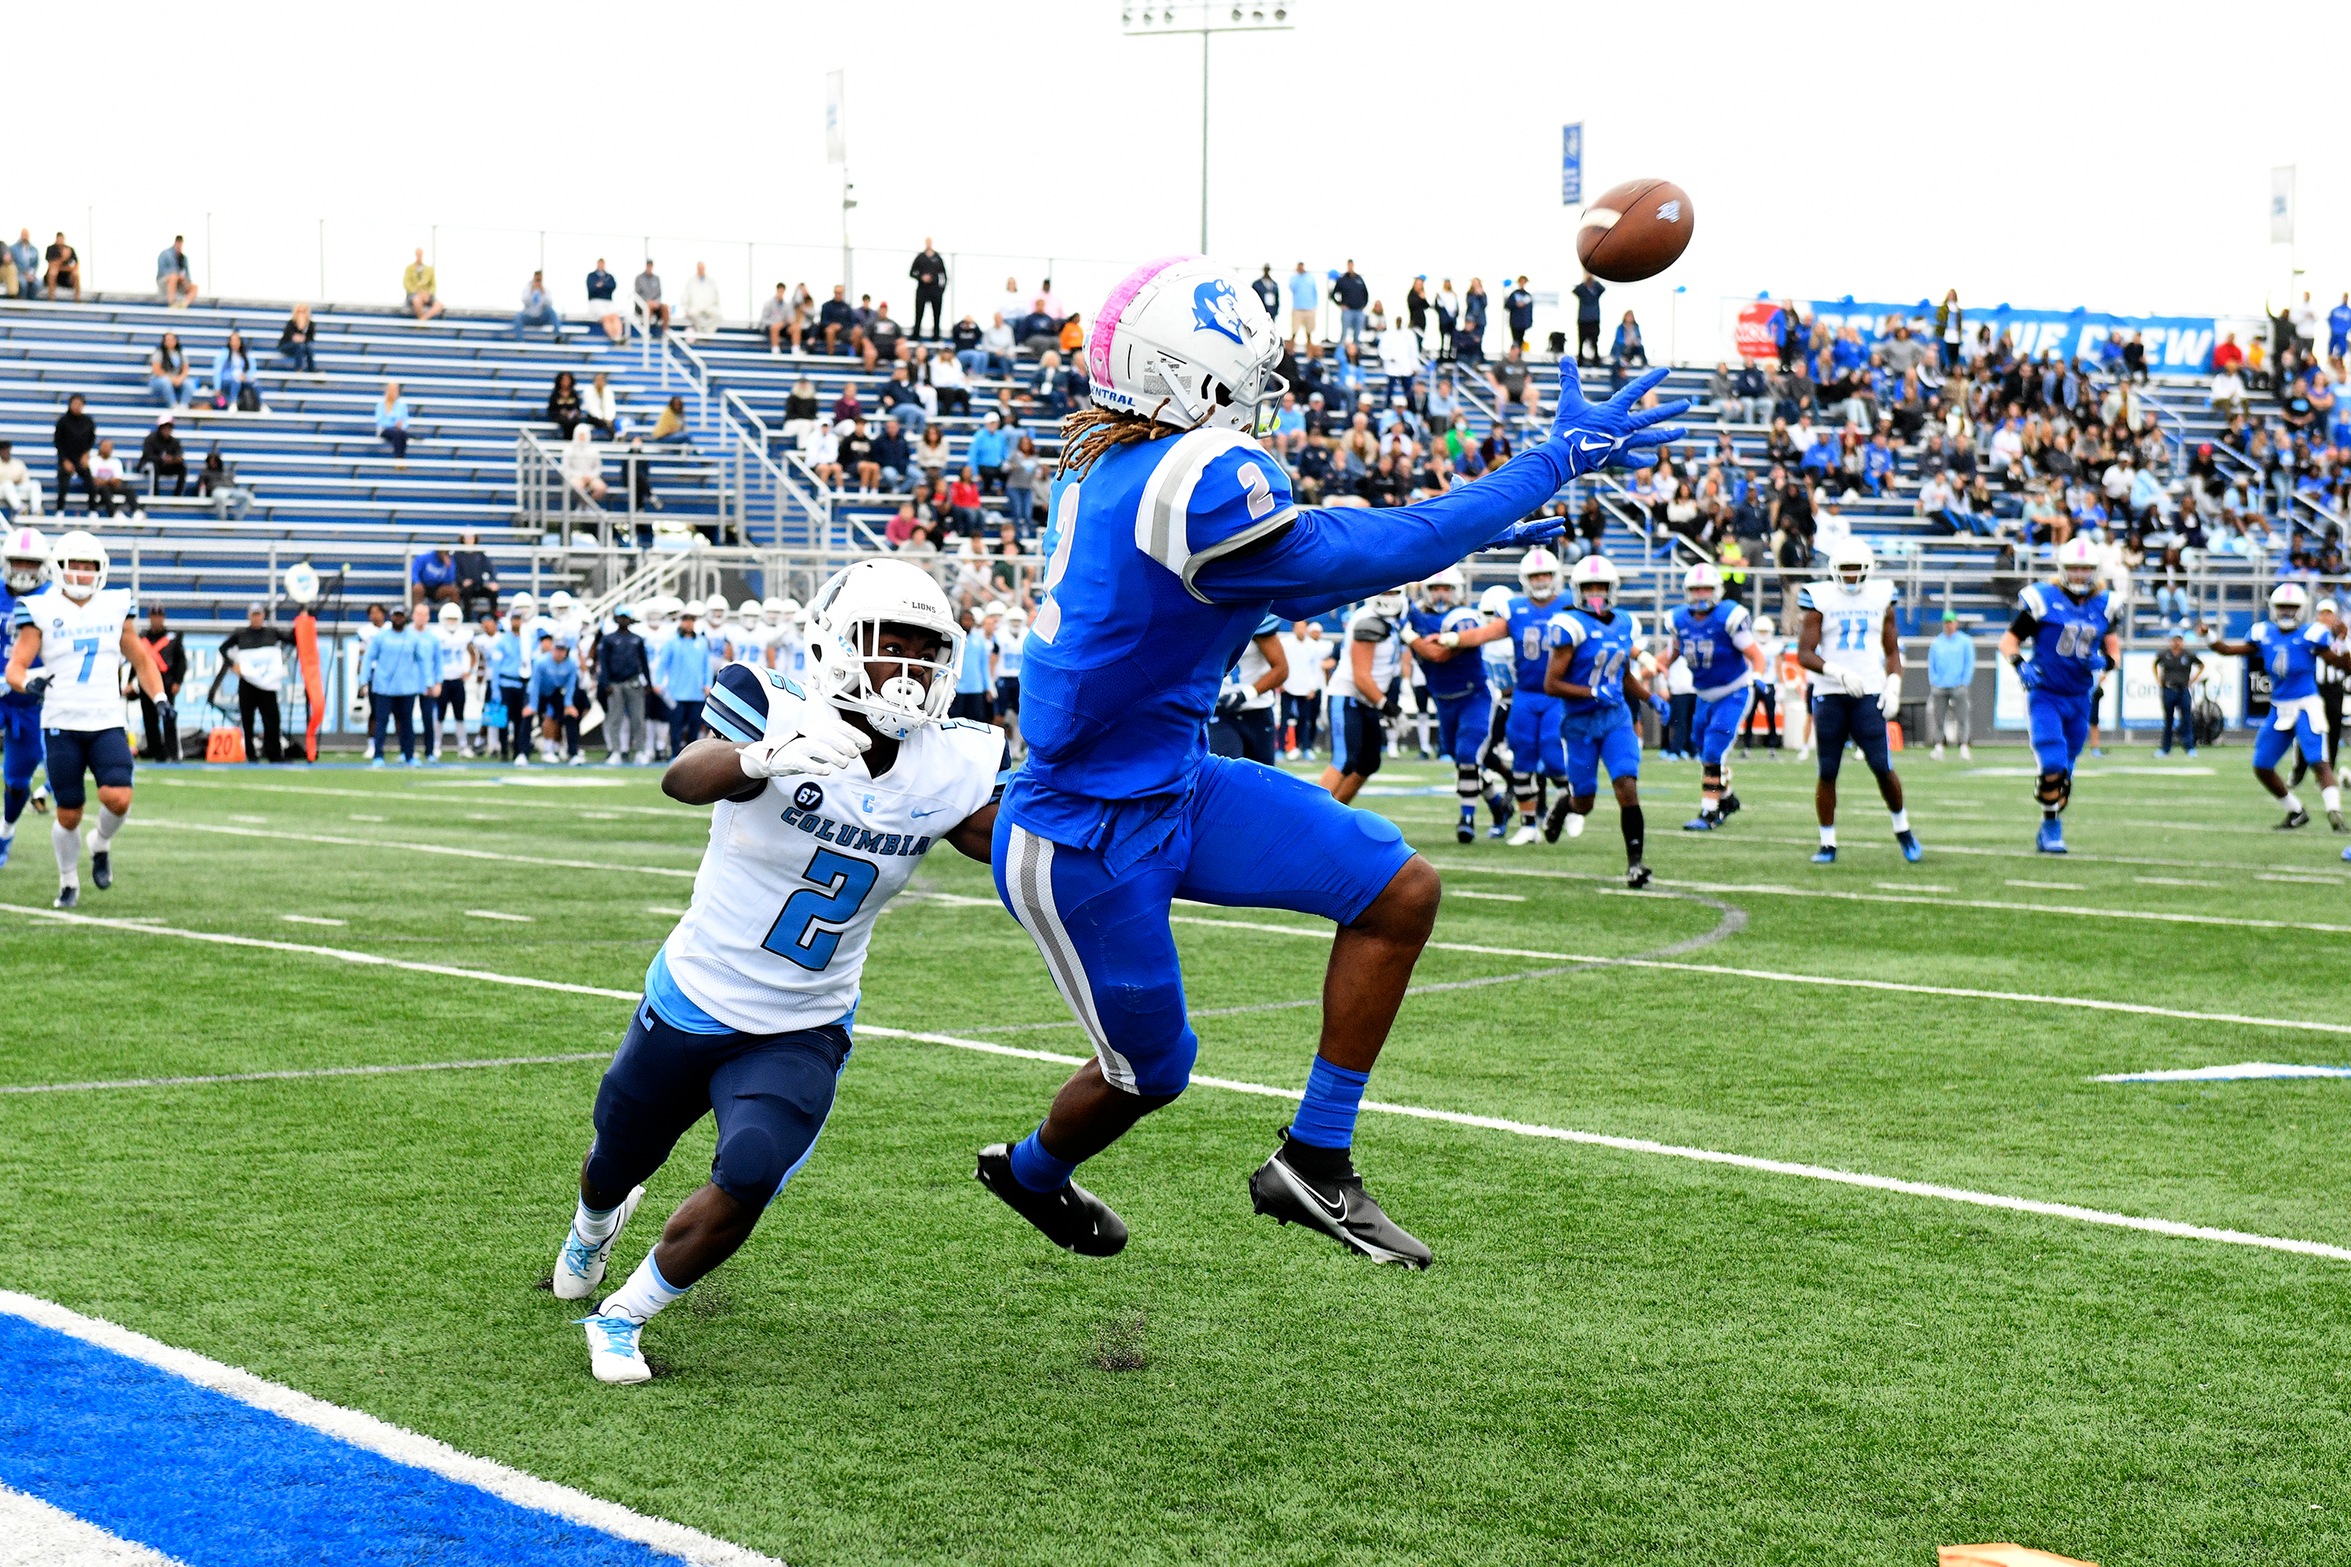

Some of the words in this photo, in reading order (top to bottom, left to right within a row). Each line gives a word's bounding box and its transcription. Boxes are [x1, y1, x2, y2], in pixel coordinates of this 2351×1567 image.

[2076, 323, 2214, 367] CEW
[1090, 385, 1136, 407] ENTRAL
[1237, 461, 1275, 520] 2
[911, 601, 937, 614] LIONS
[1837, 618, 1868, 651] 11
[73, 637, 99, 684] 7
[214, 735, 233, 756] 20
[796, 786, 822, 806] 67
[861, 793, 876, 814] C
[781, 806, 932, 857] COLUMBIA
[761, 846, 880, 972] 2
